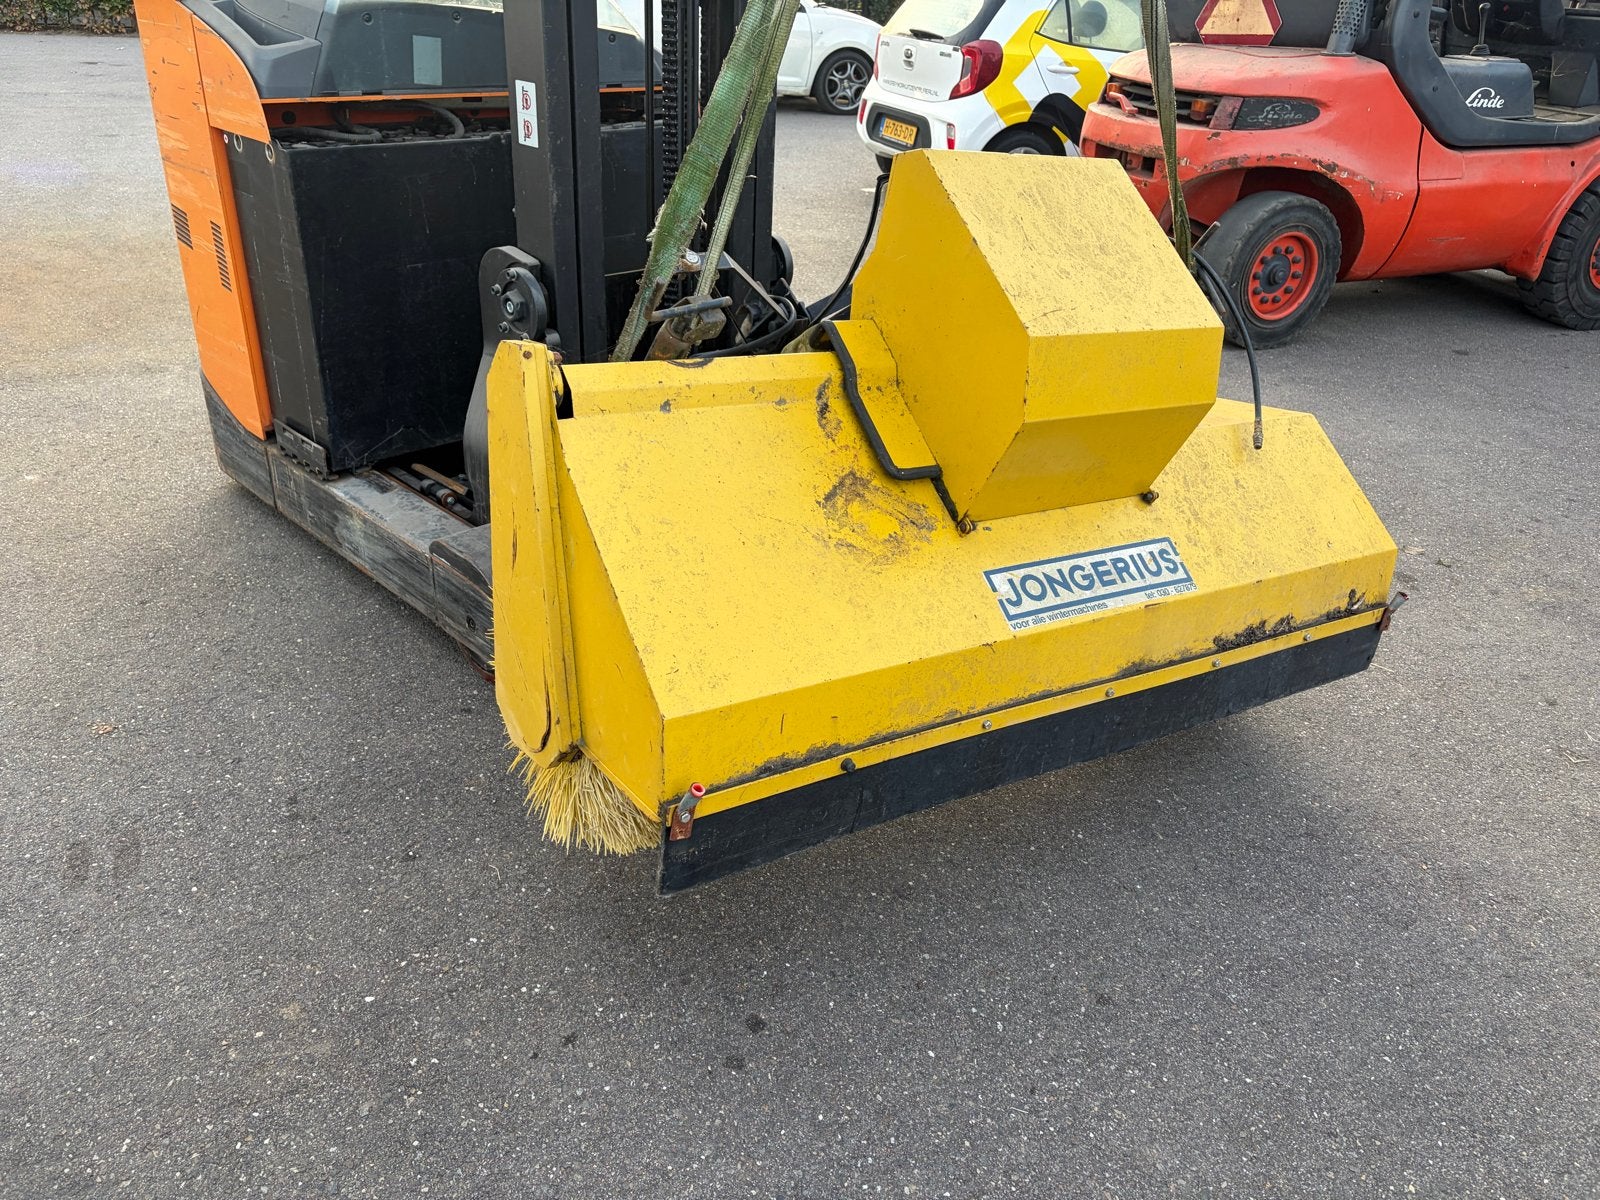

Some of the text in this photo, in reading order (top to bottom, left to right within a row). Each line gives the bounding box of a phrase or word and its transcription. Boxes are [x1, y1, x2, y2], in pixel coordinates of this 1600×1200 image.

[1465, 87, 1504, 108] Linde
[884, 120, 914, 142] H-763-DR
[1005, 548, 1179, 607] JONGERIUS
[1010, 601, 1109, 630] voor alle wintermachines
